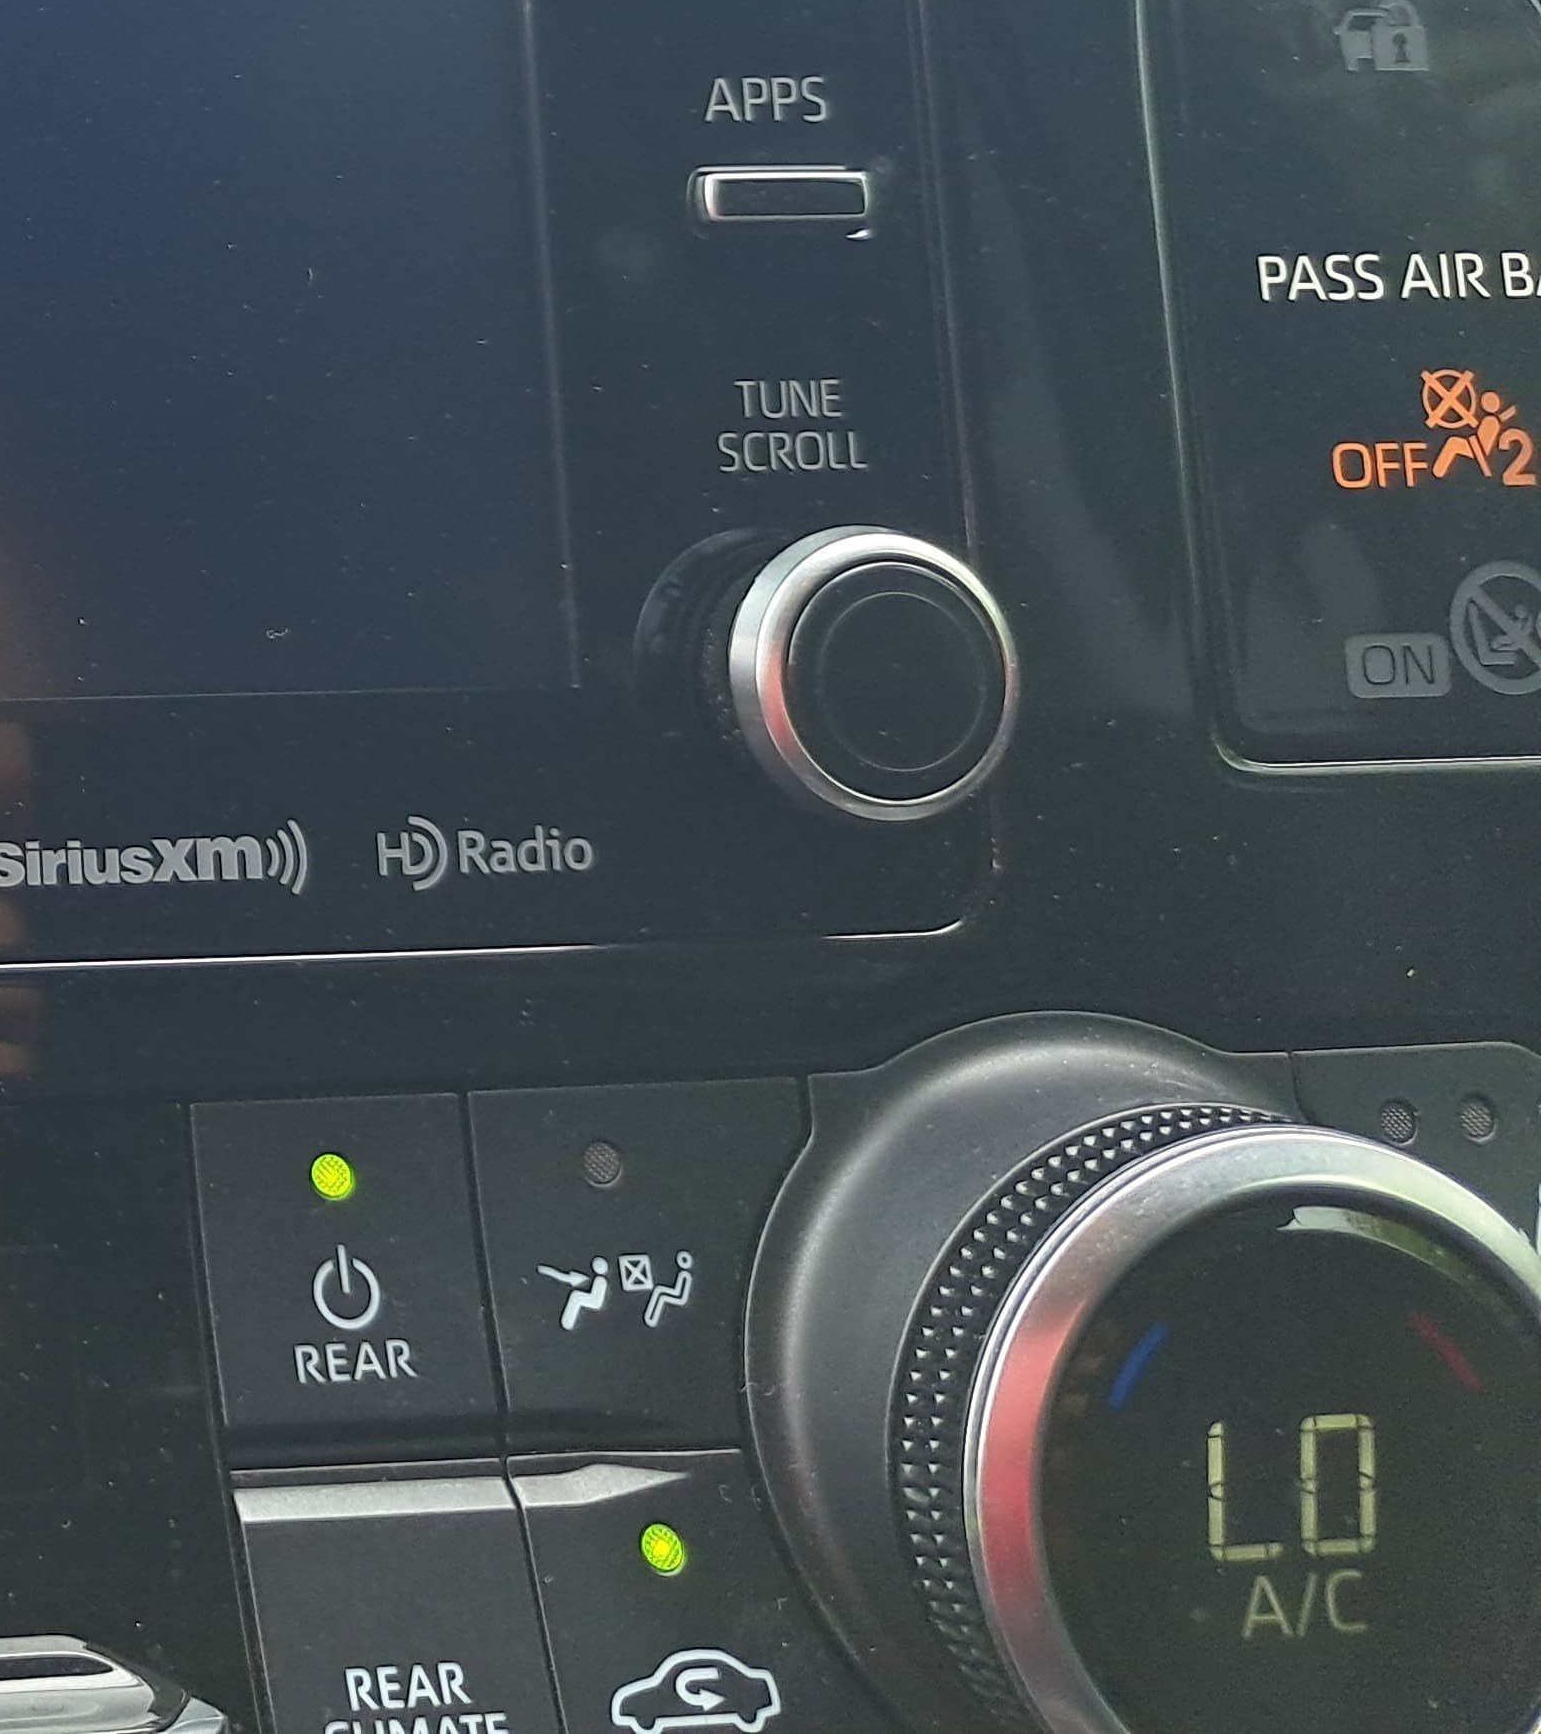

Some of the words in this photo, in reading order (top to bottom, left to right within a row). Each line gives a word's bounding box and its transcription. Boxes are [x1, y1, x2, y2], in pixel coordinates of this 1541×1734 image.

[706, 77, 827, 121] APPS
[1259, 254, 1384, 300] PASS
[1402, 253, 1490, 297] AIR
[735, 380, 841, 418] TUNE
[719, 432, 866, 471] SCROLL
[1333, 443, 1427, 487] OFF
[1363, 644, 1434, 686] ON
[378, 817, 448, 890] HD
[459, 826, 593, 873] Radio
[296, 1341, 416, 1383] REAR
[1244, 1570, 1365, 1637] A/C
[347, 1663, 471, 1711] REAR
